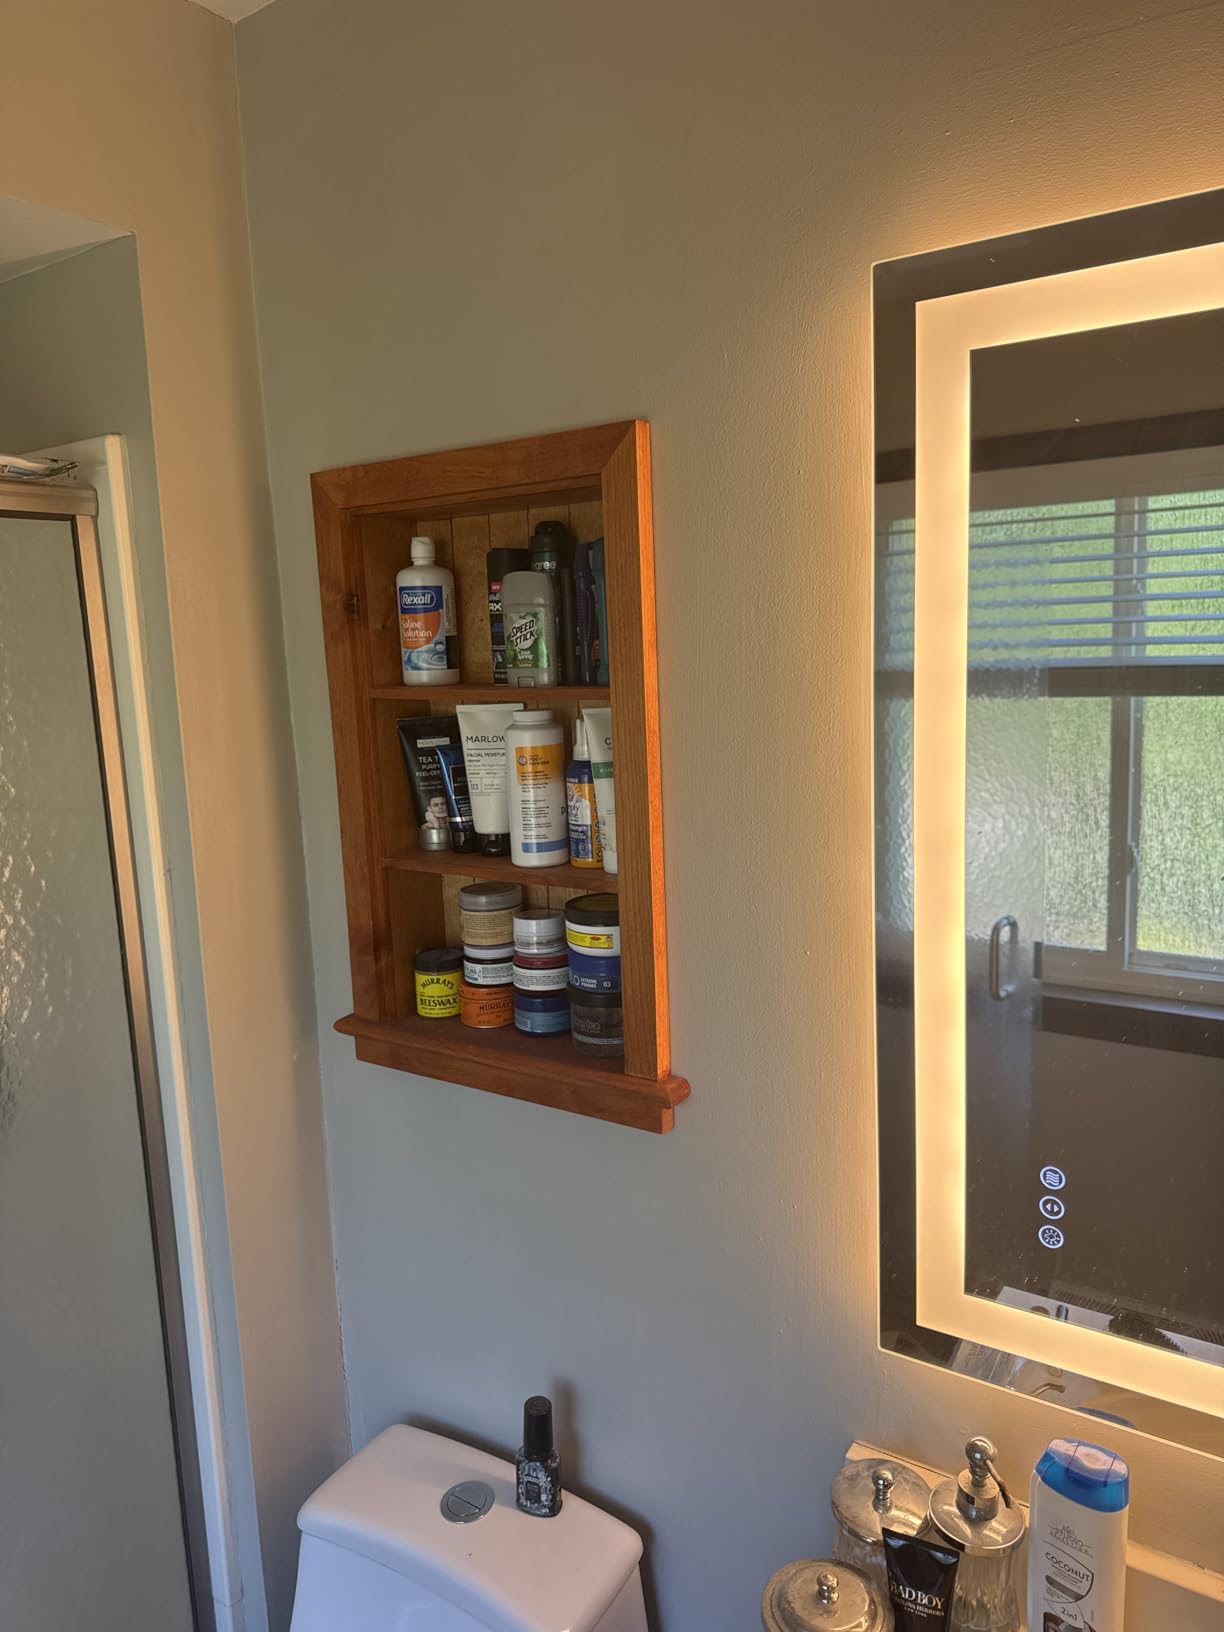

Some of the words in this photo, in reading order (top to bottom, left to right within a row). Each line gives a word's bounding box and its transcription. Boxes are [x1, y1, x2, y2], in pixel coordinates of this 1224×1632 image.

[402, 593, 431, 605] Rexall
[401, 618, 422, 629] Saline
[511, 619, 535, 638] SPEED
[402, 628, 433, 637] Solution
[513, 628, 536, 647] STICK
[419, 756, 432, 764] TEA
[420, 997, 458, 1007] BEESWAX
[1045, 1552, 1091, 1582] COCONUT
[889, 1581, 916, 1601] BAD
[917, 1590, 945, 1610] BOY
[1061, 1607, 1078, 1621] 2in1
